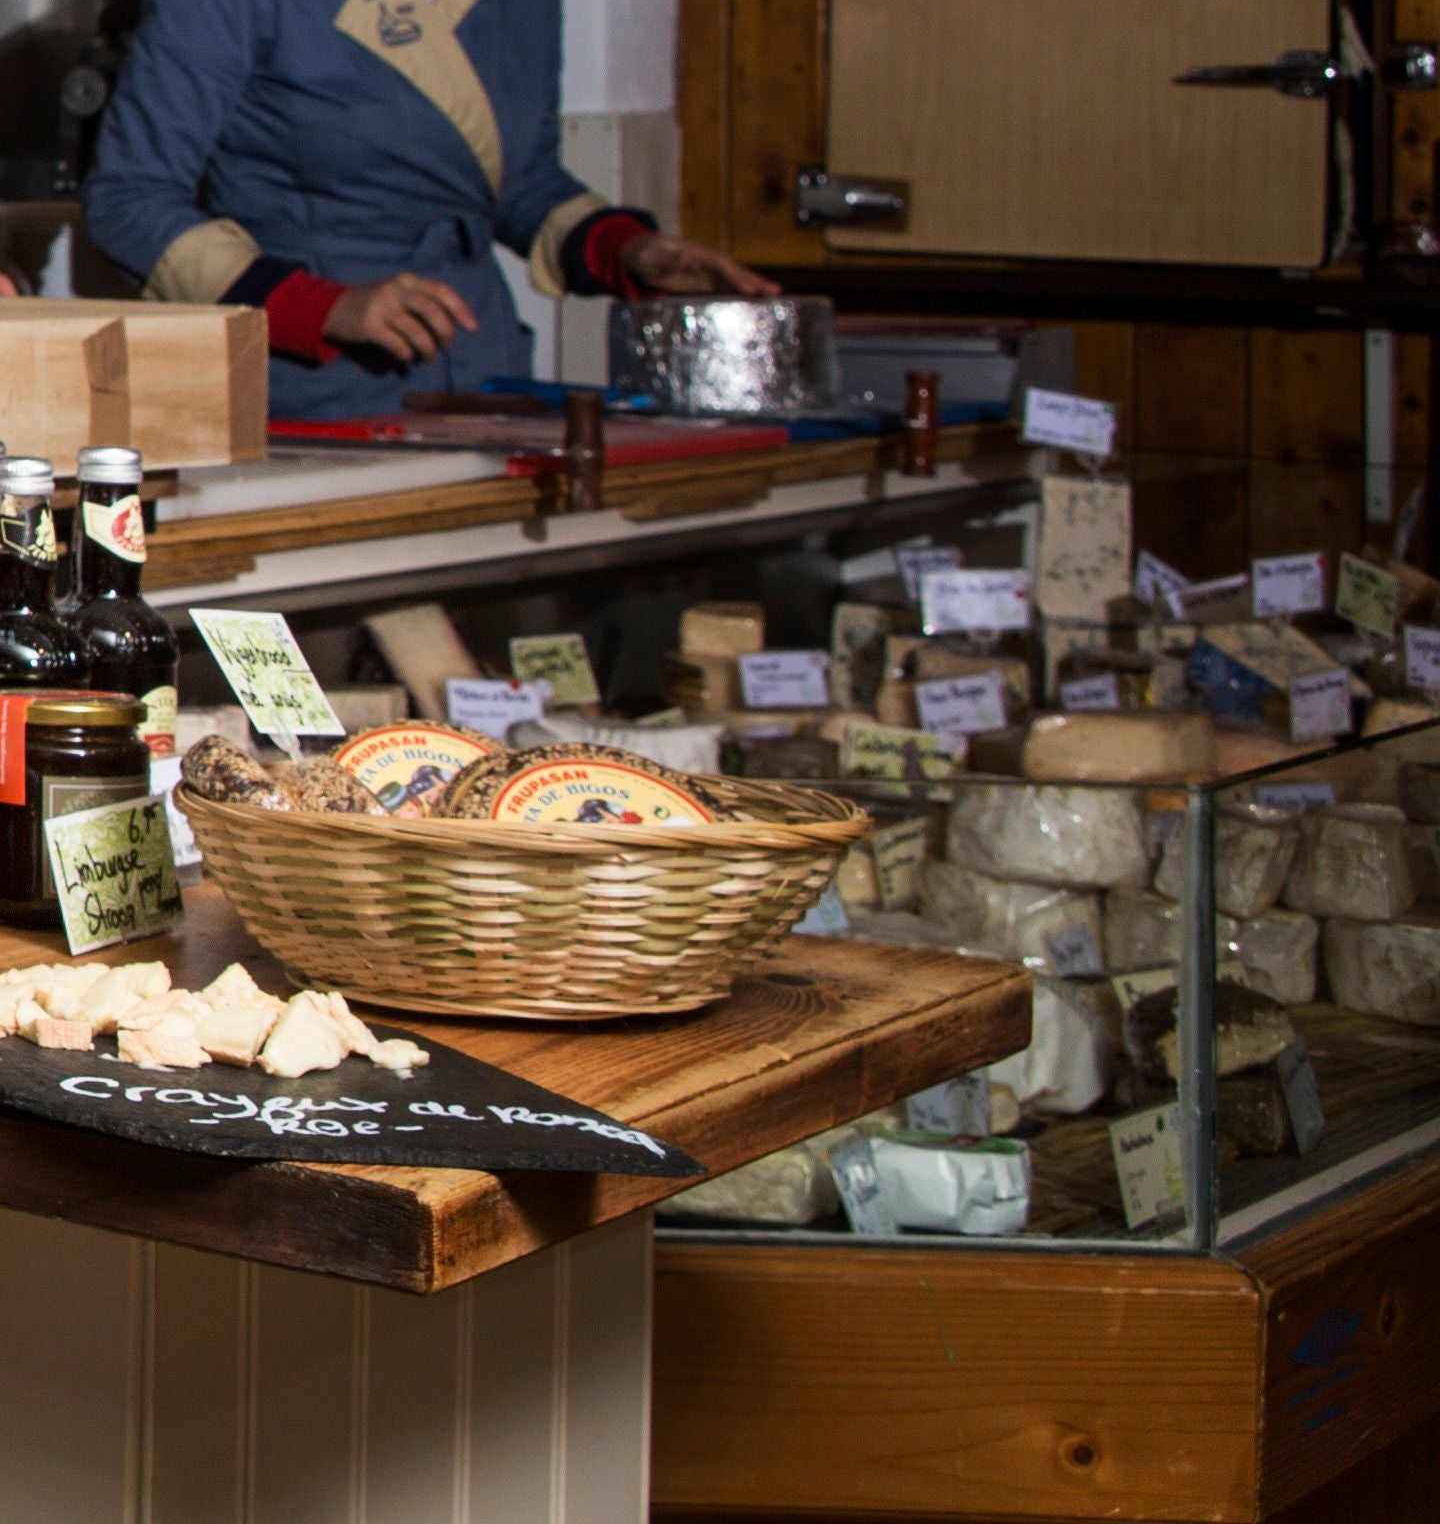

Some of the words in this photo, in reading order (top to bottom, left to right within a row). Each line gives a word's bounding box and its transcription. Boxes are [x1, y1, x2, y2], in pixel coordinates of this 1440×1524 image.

[345, 735, 427, 774] FRUPASAN
[379, 752, 397, 769] DE
[507, 769, 590, 813] FRUPASAN
[538, 789, 562, 806] DE
[566, 783, 631, 801] HIGOS
[59, 1075, 388, 1121] Crayeux
[408, 1101, 484, 1122] de
